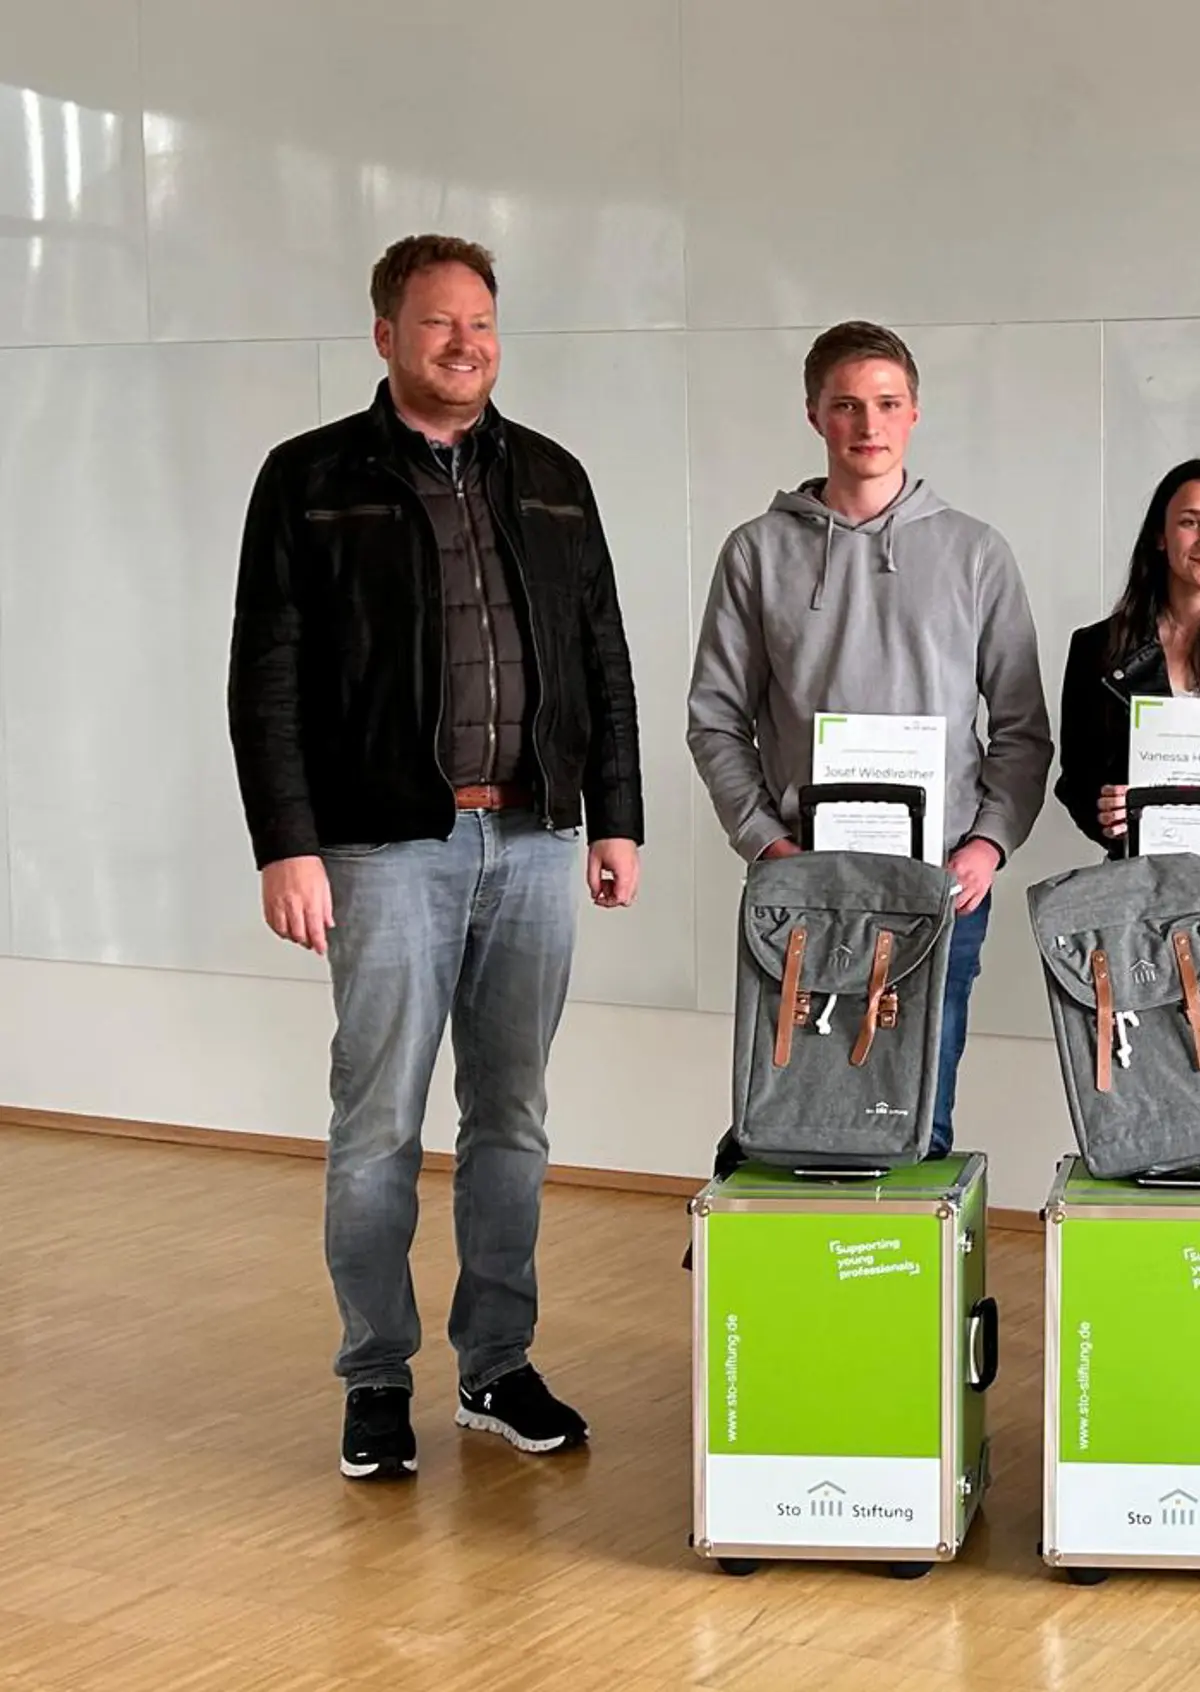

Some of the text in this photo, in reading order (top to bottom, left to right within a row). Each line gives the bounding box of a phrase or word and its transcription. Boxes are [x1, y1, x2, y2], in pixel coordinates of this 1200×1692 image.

[1139, 751, 1189, 763] Vanessa
[824, 765, 855, 778] Josef
[836, 1239, 900, 1255] Supporting
[837, 1255, 874, 1269] young
[839, 1262, 915, 1280] professionals
[726, 1314, 740, 1442] www.sto-stiftung.de
[1078, 1321, 1092, 1450] www.sto-stiftung.de
[777, 1502, 914, 1521] Sto Stiftung
[1128, 1511, 1152, 1526] Sto
